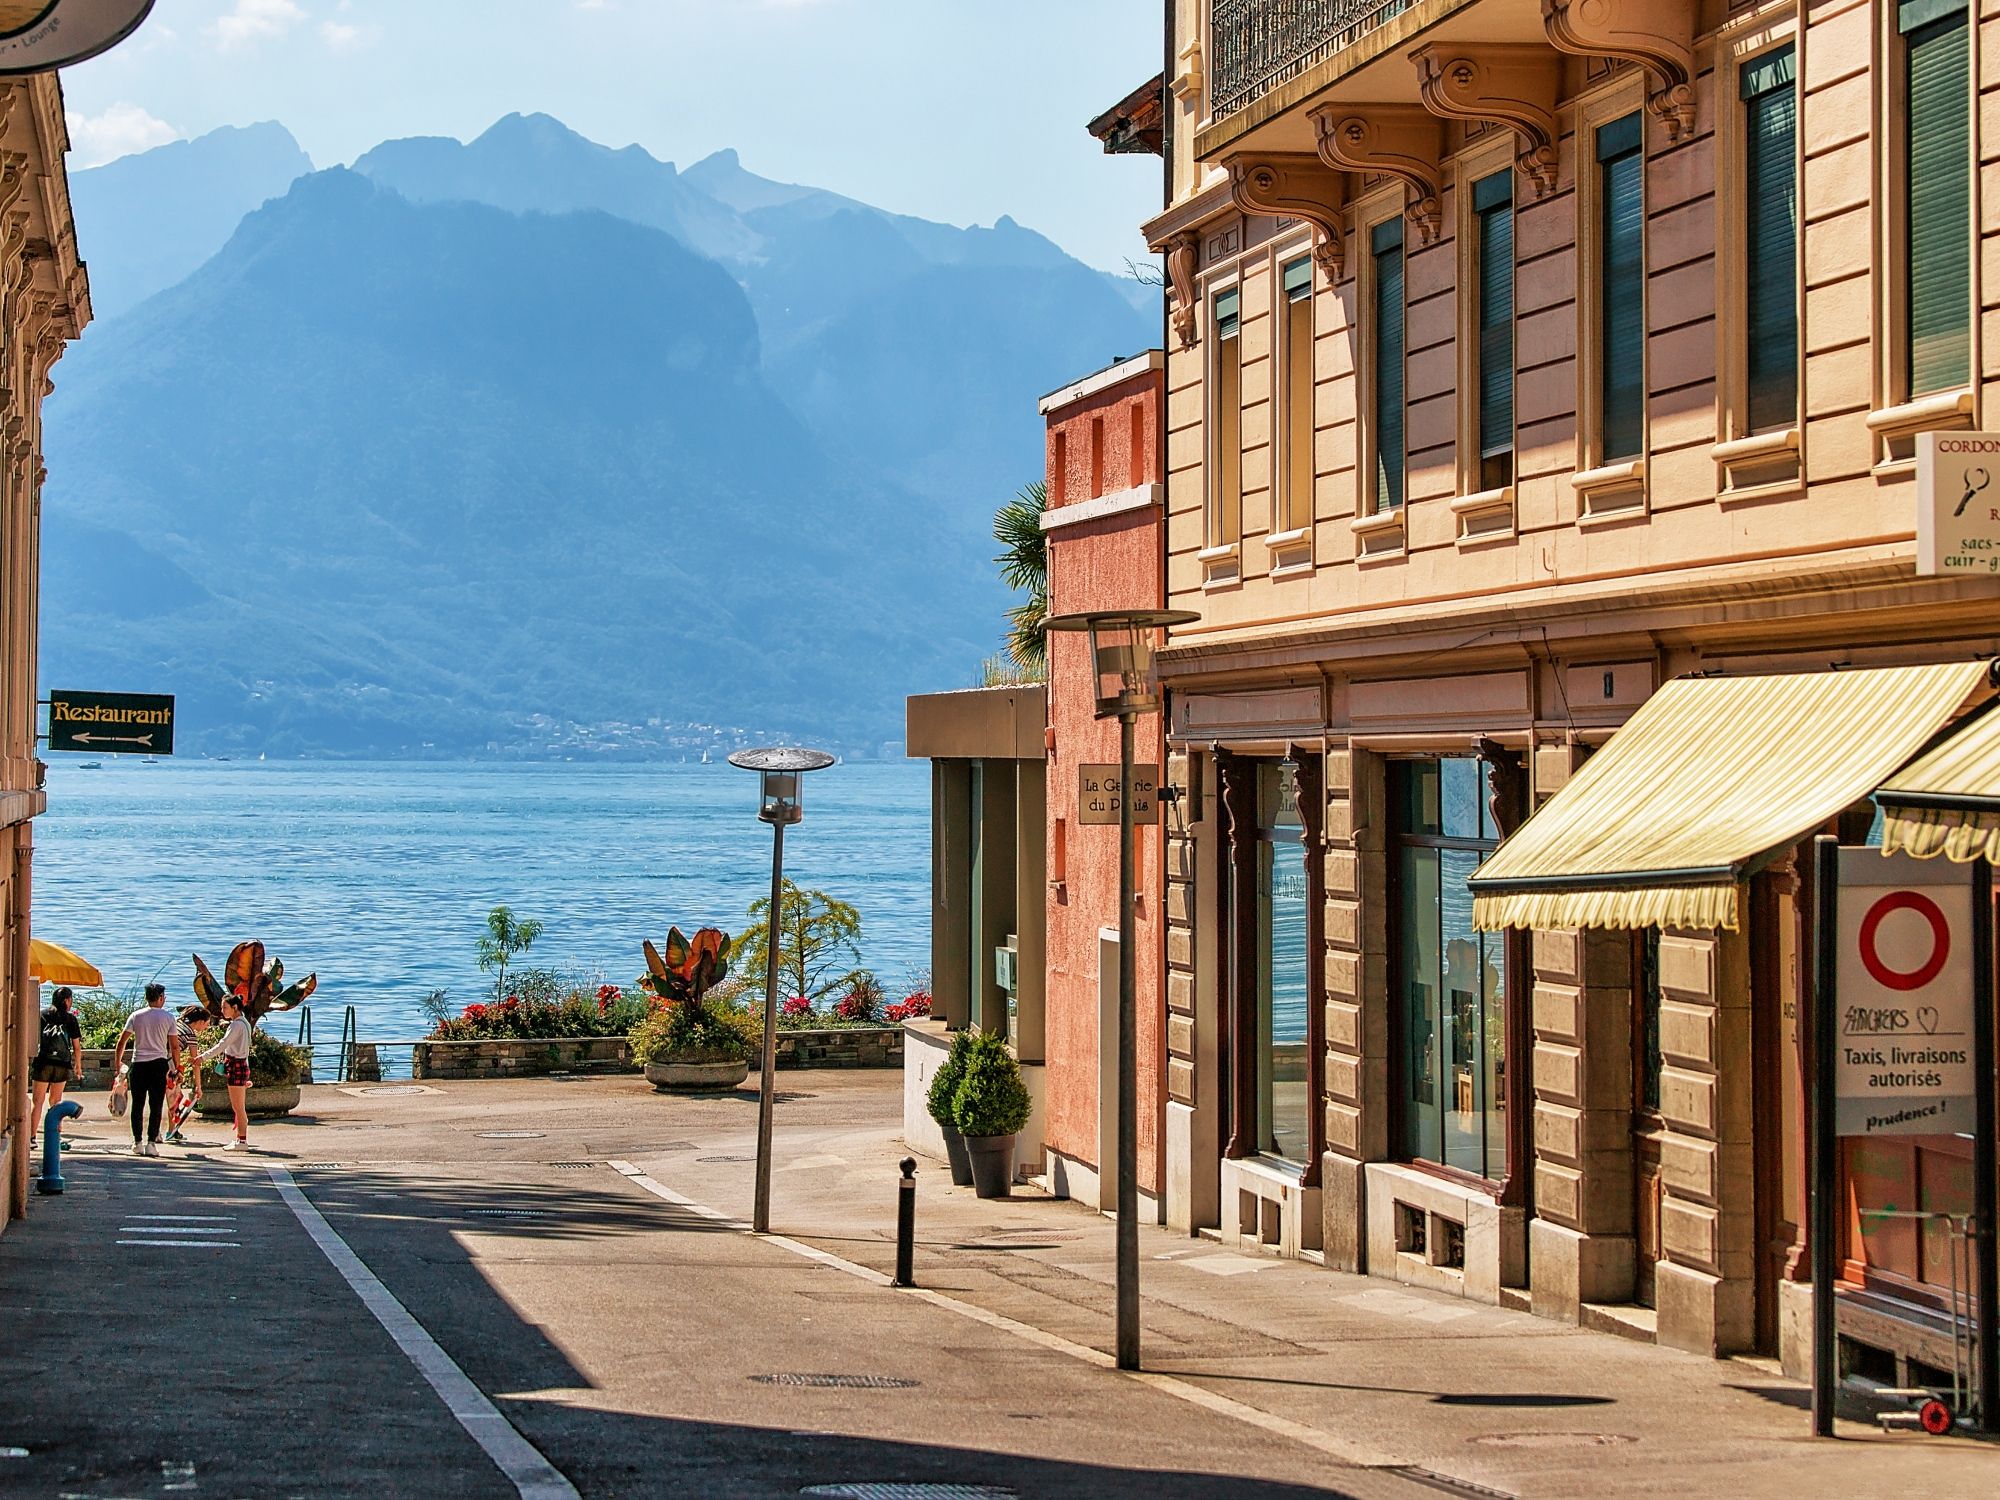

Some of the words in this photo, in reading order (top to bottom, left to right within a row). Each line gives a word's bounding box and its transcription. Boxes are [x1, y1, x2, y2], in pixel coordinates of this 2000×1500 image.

[21, 17, 61, 47] Lounge
[1961, 539, 1992, 550] sacs
[1944, 550, 1976, 567] cuir
[54, 701, 171, 724] Restaurant
[1085, 779, 1099, 792] La
[1104, 778, 1153, 792] Garie
[1089, 798, 1105, 811] du
[1110, 798, 1149, 812] Pis
[1844, 1047, 1886, 1066] Taxis,
[1891, 1047, 1967, 1064] livraisons
[1869, 1069, 1942, 1087] autorisés
